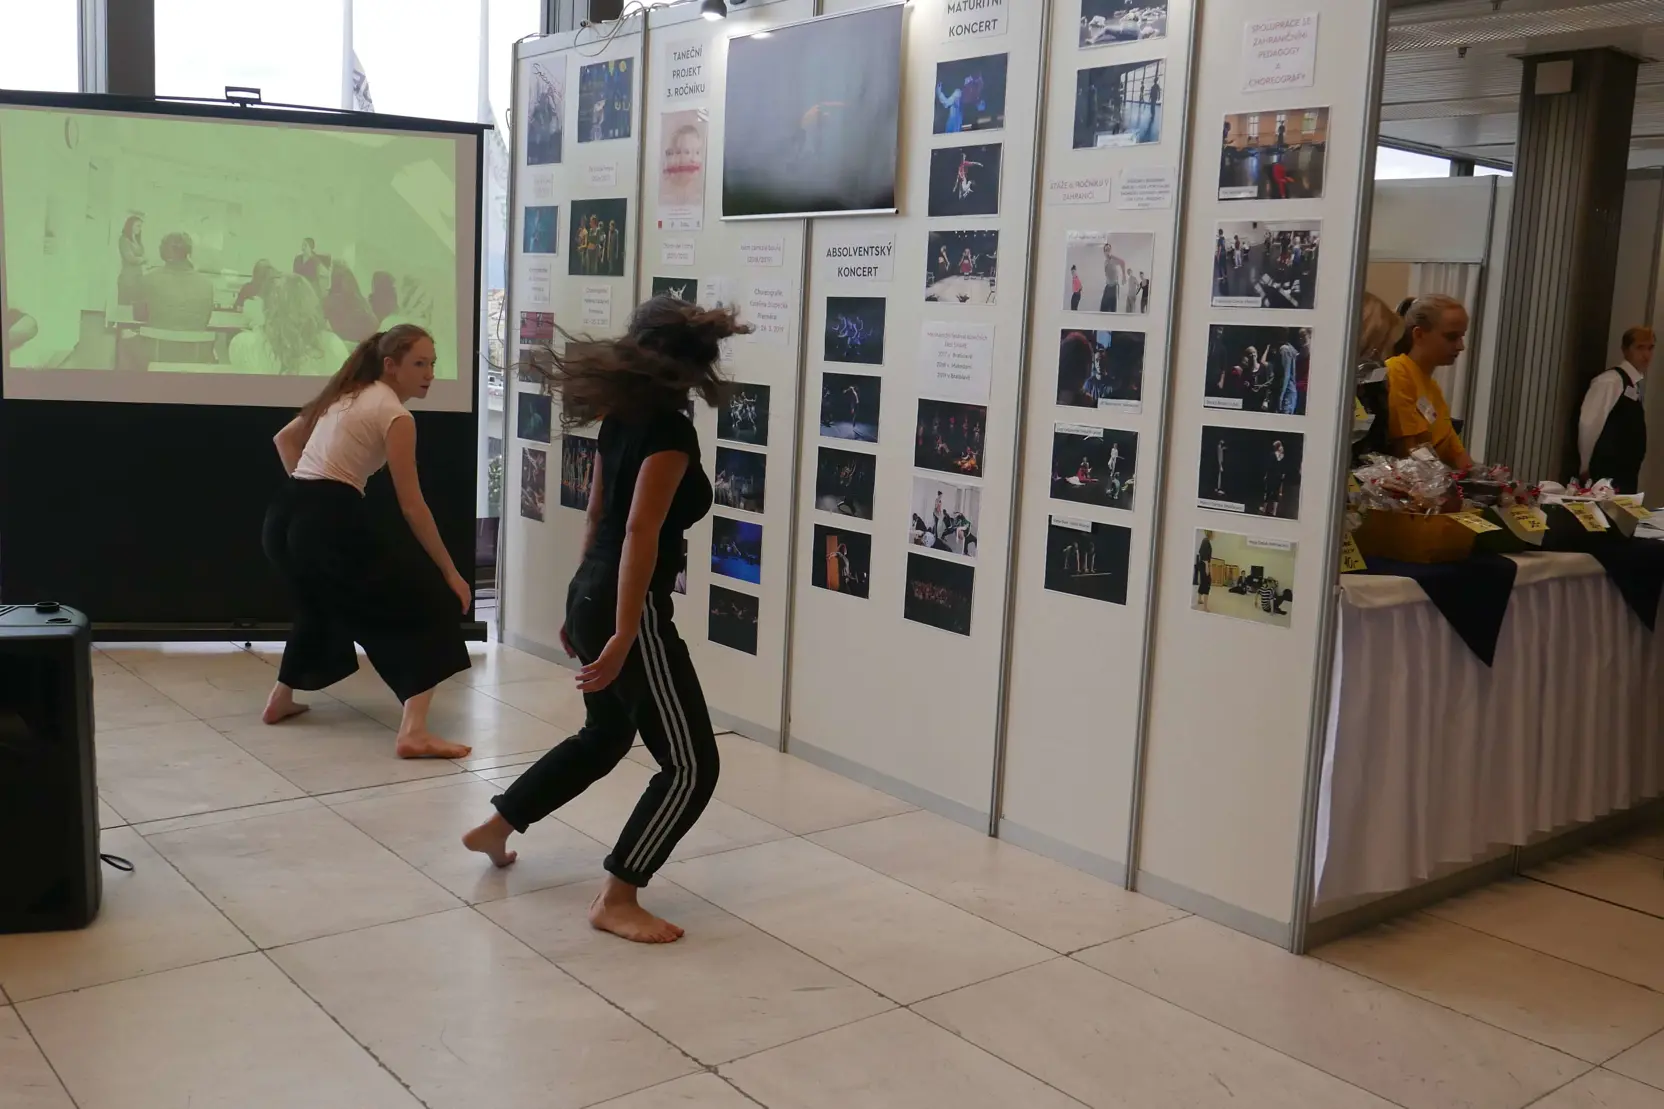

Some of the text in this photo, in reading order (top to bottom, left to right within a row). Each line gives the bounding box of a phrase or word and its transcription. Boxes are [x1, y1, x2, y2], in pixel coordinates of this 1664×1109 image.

[948, 18, 998, 37] KONCERT
[673, 44, 703, 61] TANEČNÍ
[672, 65, 702, 80] PROJEKT
[674, 82, 705, 96] ROČNÍKU
[826, 241, 892, 258] ABSOLVENTSKÝ
[837, 266, 879, 278] KONCERT
